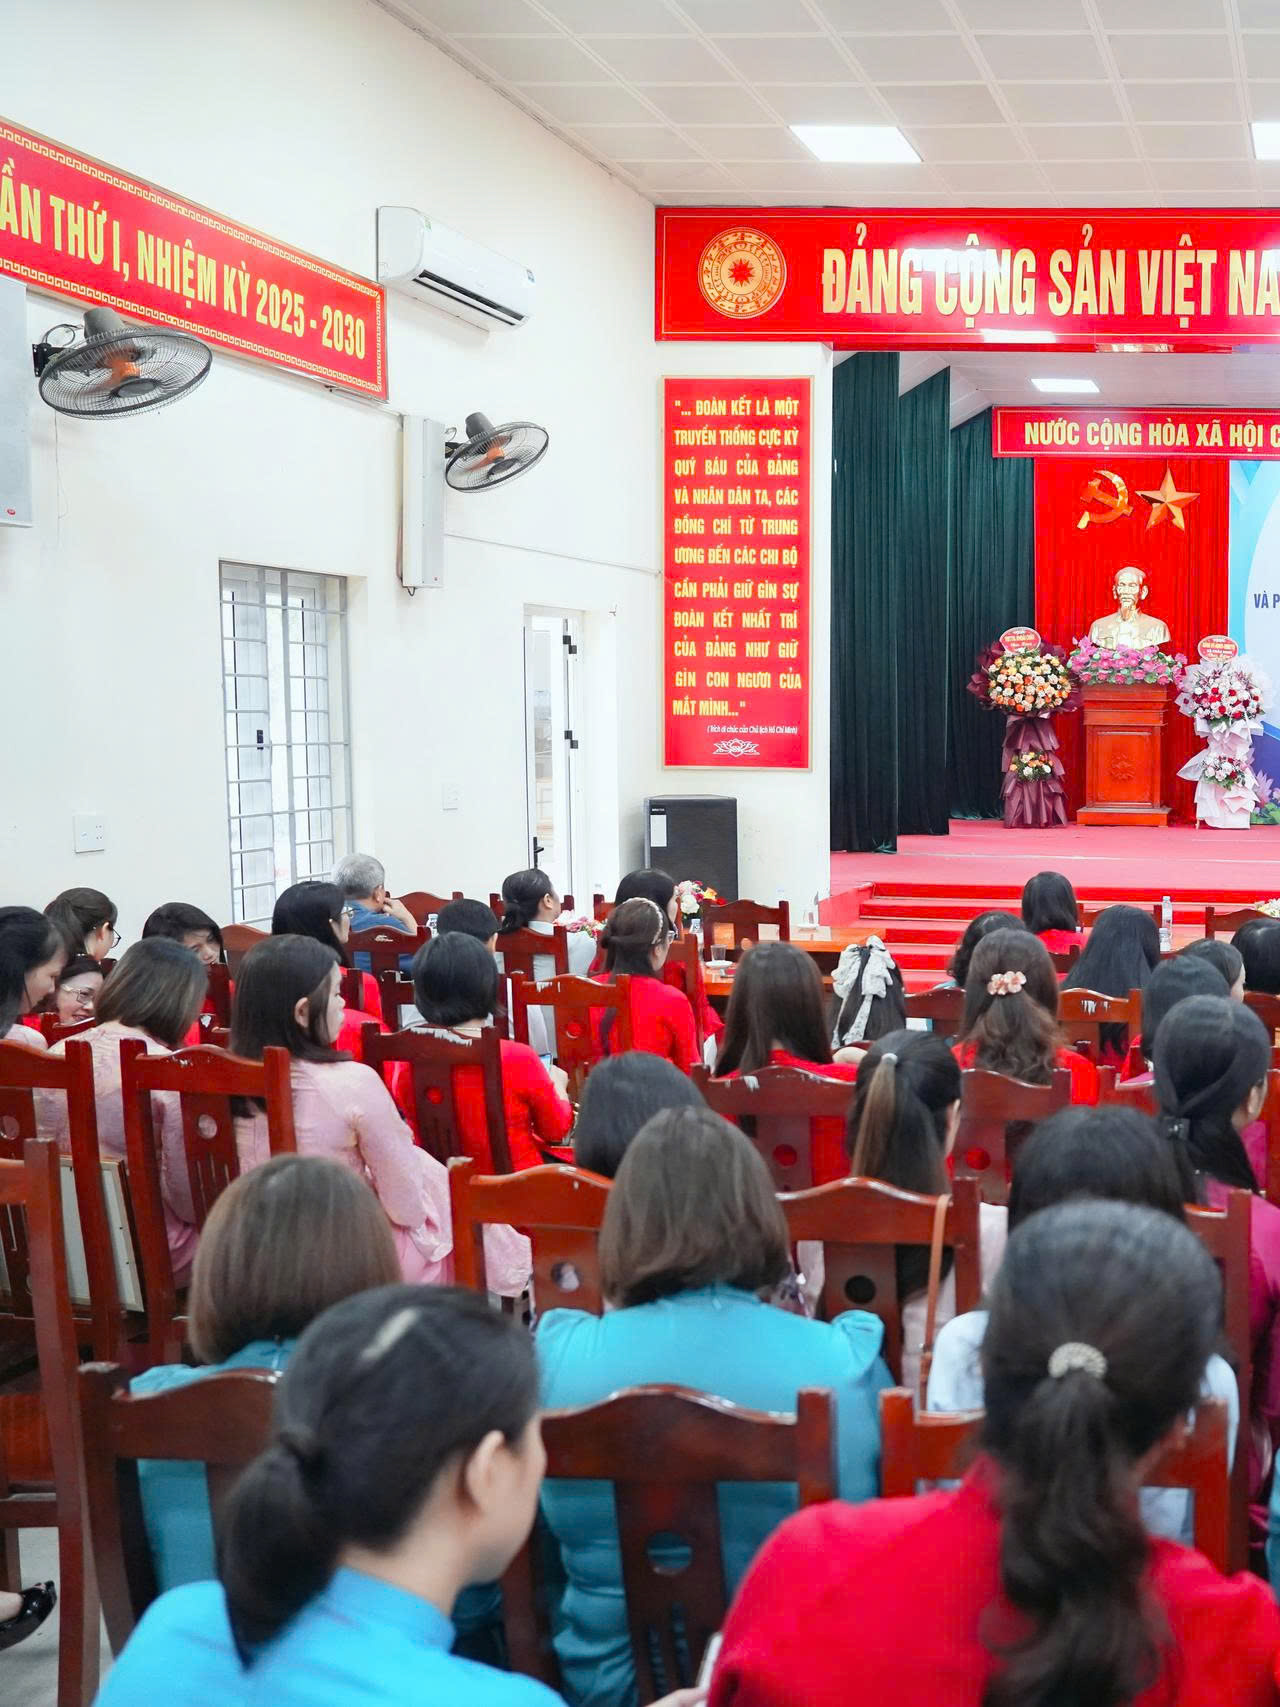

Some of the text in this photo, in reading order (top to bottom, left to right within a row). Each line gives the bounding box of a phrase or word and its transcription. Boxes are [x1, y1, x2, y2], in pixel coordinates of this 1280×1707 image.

[50, 194, 107, 265] THỨ
[113, 220, 129, 281] I,
[137, 231, 217, 309] NHIỆM
[224, 260, 250, 317] KỲ
[256, 279, 305, 337] 2025
[322, 307, 365, 359] 2030
[822, 223, 923, 314] ĐẢNG
[936, 234, 1036, 328] CỘNG
[1048, 224, 1126, 316] SẢN
[1139, 234, 1216, 328] VIỆT
[696, 397, 726, 415] ĐOÀN
[731, 395, 751, 415] KẾT
[756, 397, 769, 415] LÀ
[775, 397, 799, 419] MỘT
[759, 429, 781, 448] CỰC
[784, 427, 799, 445] KỲ
[1025, 418, 1080, 445] NƯỚC
[1087, 419, 1141, 450] CỘNG
[1149, 419, 1189, 446] HÒA
[1196, 420, 1223, 447] XÃ
[1230, 420, 1263, 452] HỘI
[675, 453, 798, 476] QUÝ BÁU CỦA ĐẢNG
[675, 486, 798, 506] VÀ NHÂN DÂN TA, CÁC
[713, 516, 731, 534] CHÍ
[740, 516, 755, 534] TỪ
[761, 519, 798, 535] TRUNG
[675, 544, 797, 568] ƯƠNG ĐẾN CÁC CHI BỘ
[703, 576, 728, 598] PHẢI
[734, 579, 754, 598] GIỮ
[758, 580, 777, 598] GÌN
[782, 582, 799, 602] SỰ
[1254, 591, 1269, 608] VÀ
[674, 607, 797, 628] ĐOÀN KẾT NHẤT TRÍ
[674, 635, 798, 658] CỦA ĐẢNG NHƯ GIỮ
[676, 668, 696, 687] GÌN
[706, 672, 729, 687] CON
[780, 667, 801, 689] CỦA
